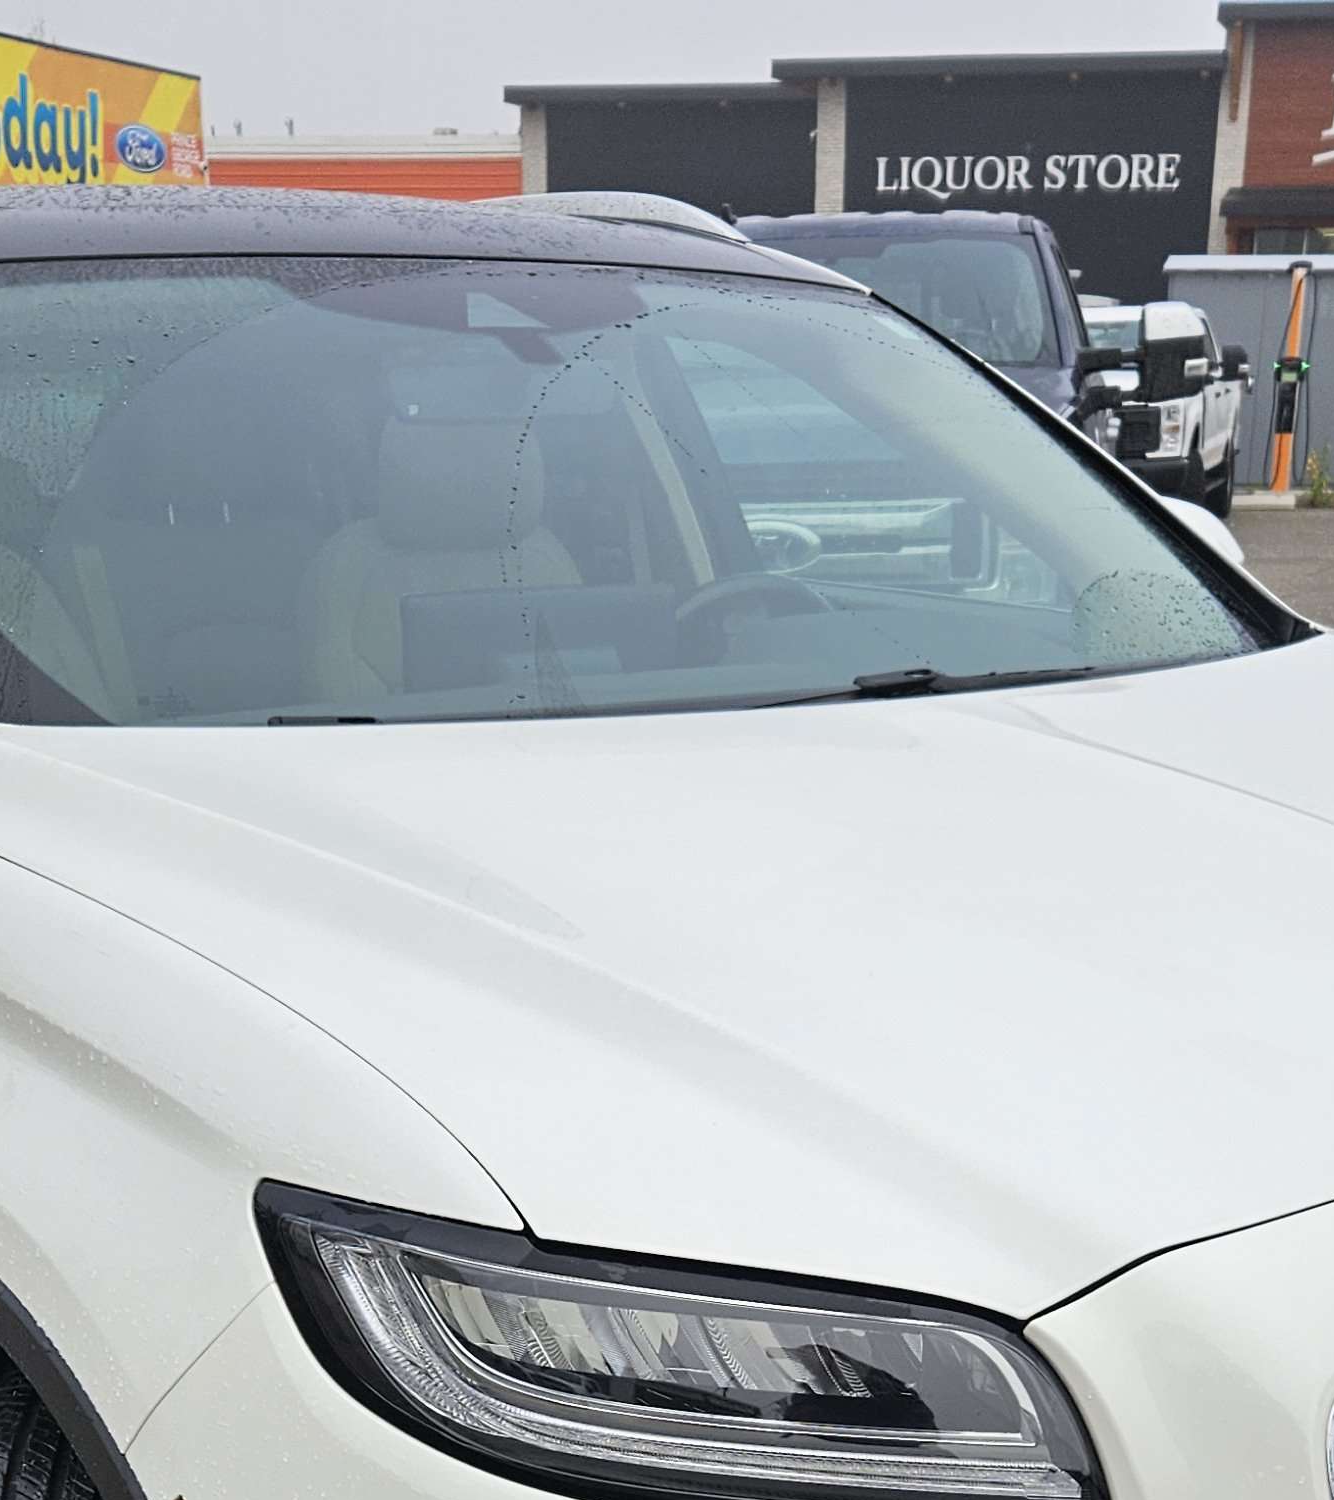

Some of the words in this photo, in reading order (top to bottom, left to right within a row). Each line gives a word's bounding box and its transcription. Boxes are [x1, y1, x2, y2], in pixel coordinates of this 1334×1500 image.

[123, 129, 158, 167] Ford
[875, 155, 1034, 199] LIQUOR
[1043, 153, 1181, 191] STORE
